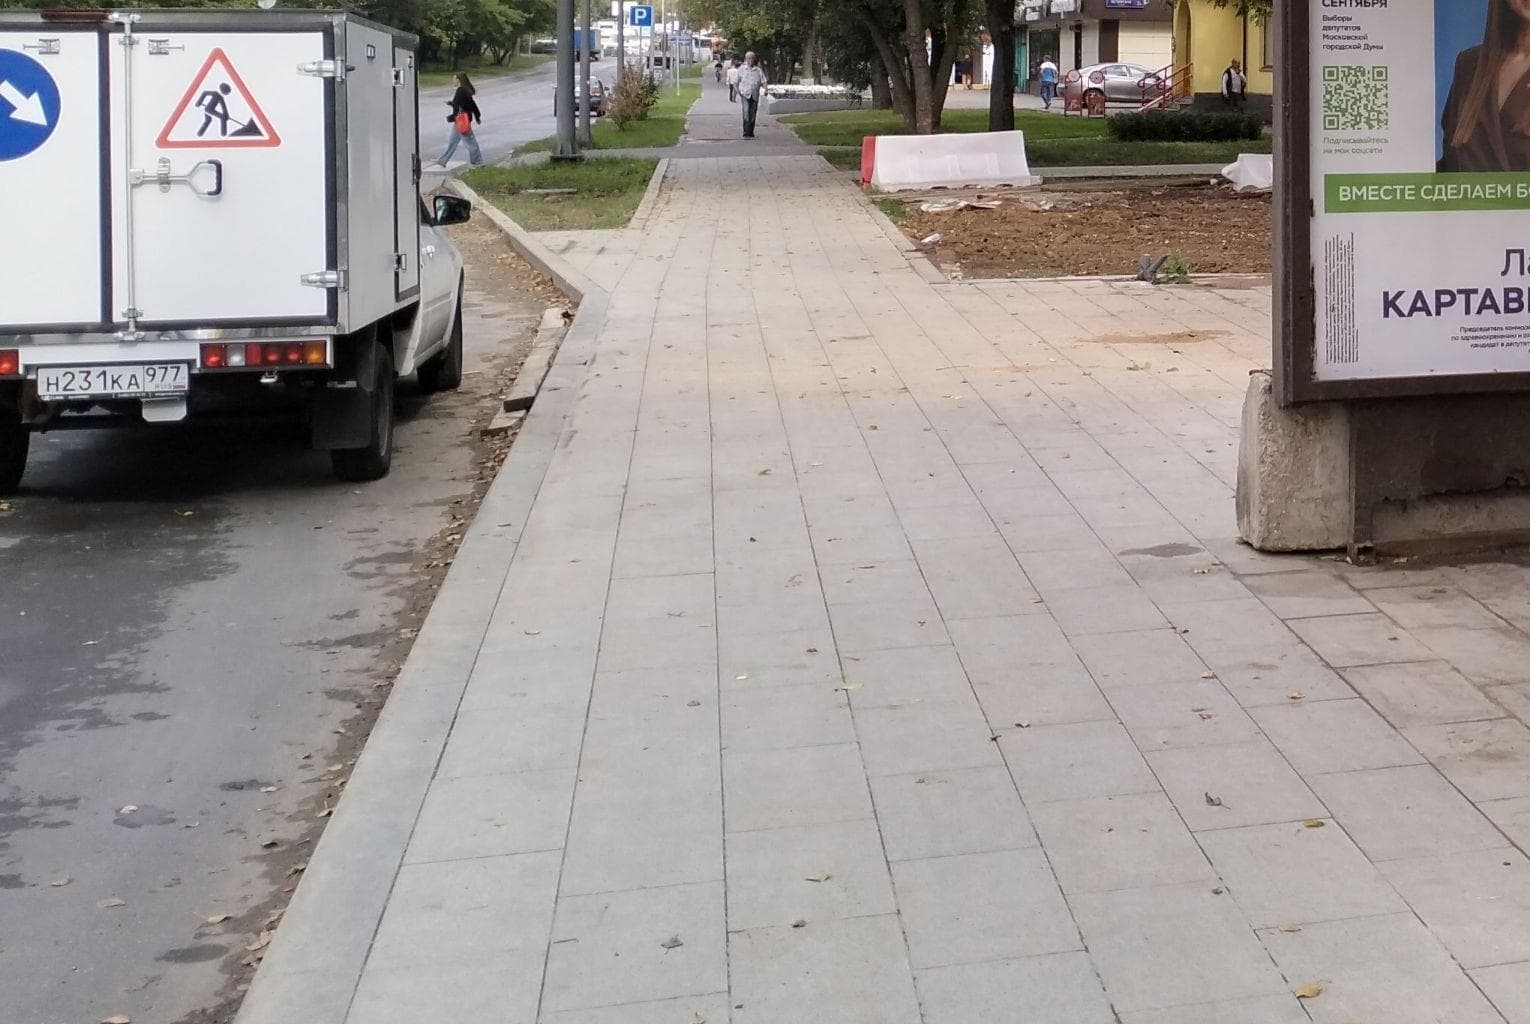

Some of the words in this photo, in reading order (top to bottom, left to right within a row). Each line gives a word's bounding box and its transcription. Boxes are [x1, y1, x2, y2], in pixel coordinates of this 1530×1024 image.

[634, 8, 647, 24] P
[1338, 184, 1416, 201] ВМЕСТЕ
[1420, 183, 1512, 202] СДЕЛАЕМ
[145, 365, 181, 382] 977
